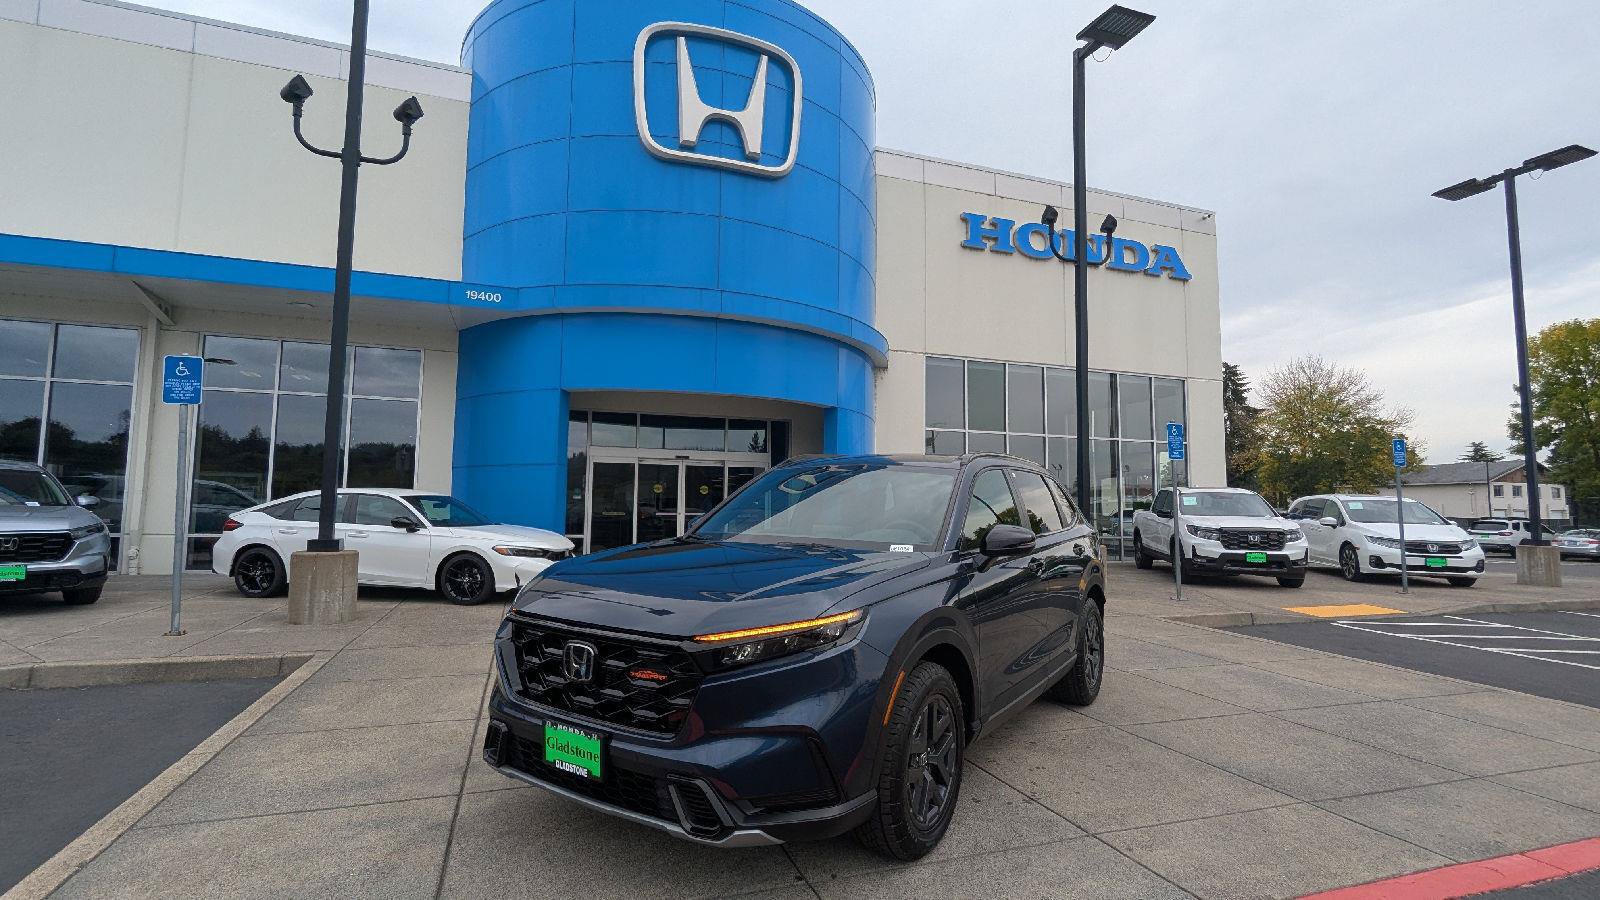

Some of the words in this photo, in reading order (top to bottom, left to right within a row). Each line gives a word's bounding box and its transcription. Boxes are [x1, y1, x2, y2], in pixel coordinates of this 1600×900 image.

[960, 211, 1192, 281] HONDA
[465, 290, 502, 303] 19400
[546, 736, 600, 763] Gladstone
[555, 759, 588, 778] GLADSTONE
